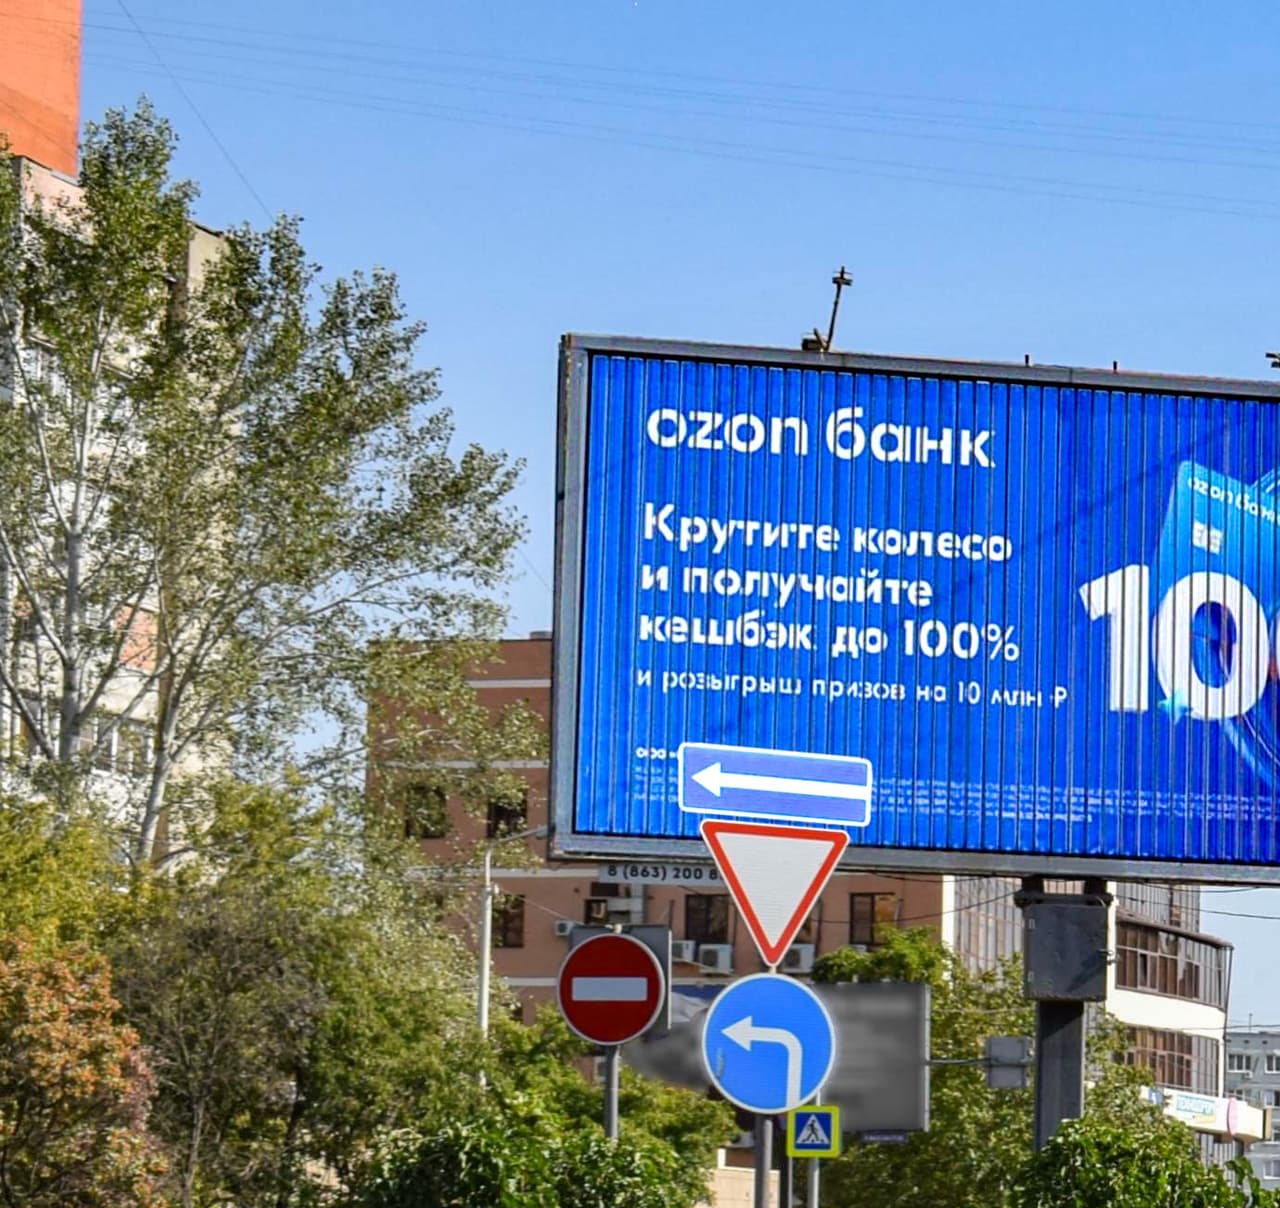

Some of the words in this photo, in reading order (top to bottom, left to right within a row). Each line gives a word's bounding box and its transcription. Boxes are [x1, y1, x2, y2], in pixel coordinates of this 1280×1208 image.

[647, 407, 808, 456] ozon
[826, 407, 996, 468] банк
[645, 502, 840, 554] Крутите
[853, 527, 1013, 562] колесо
[641, 565, 668, 591] и
[683, 565, 934, 609] получайте
[639, 610, 818, 651] кешбэк
[831, 625, 888, 660] до
[903, 619, 1020, 662] 100%
[637, 670, 651, 687] и
[662, 671, 801, 698] розыгрыш
[812, 678, 906, 702] призов
[917, 686, 946, 704] на
[958, 682, 980, 705] 10
[991, 689, 1042, 709] млн
[607, 865, 618, 876] 8
[623, 864, 666, 880] (863)
[673, 867, 703, 879] 200
